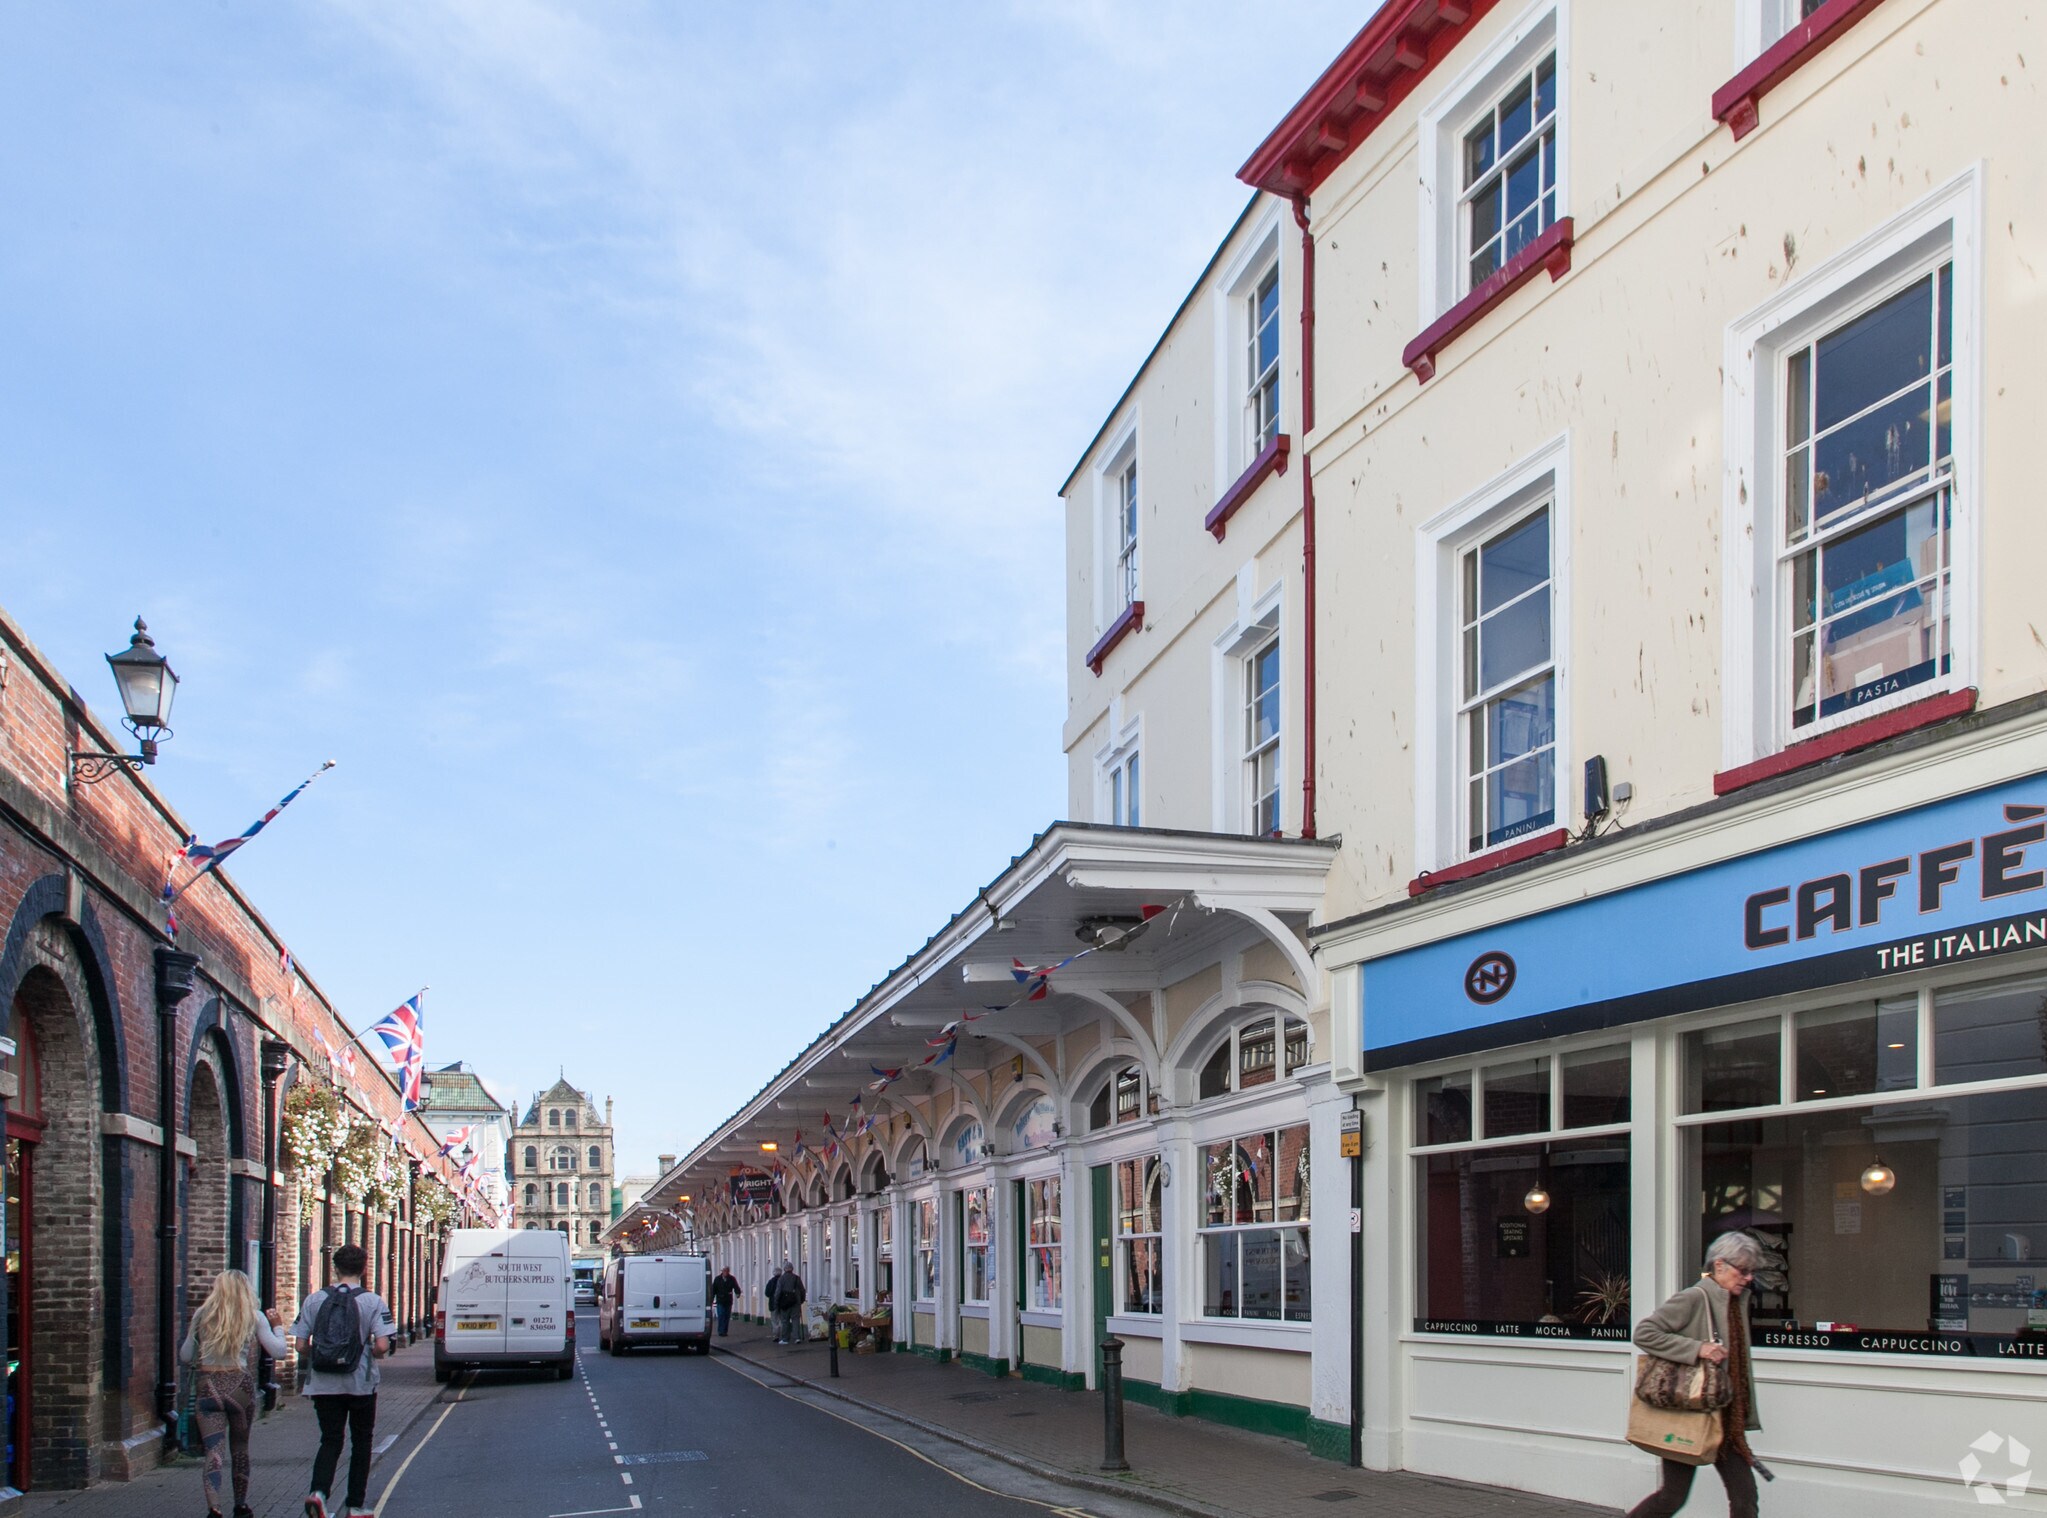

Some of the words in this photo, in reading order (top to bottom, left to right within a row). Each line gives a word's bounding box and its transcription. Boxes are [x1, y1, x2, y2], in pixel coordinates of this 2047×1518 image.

[1857, 679, 1899, 702] PASTA
[1505, 820, 1536, 838] PANINI
[1744, 803, 2046, 950] CAFFÈ
[1877, 941, 1924, 969] THE
[1933, 917, 2046, 960] ITALIAN
[498, 1263, 522, 1272] SOUTH
[524, 1263, 542, 1272] WEST
[485, 1275, 522, 1284] BUTCHERS
[523, 1275, 555, 1284] SUPPLIES
[1424, 1322, 1478, 1332] CAPPUCCINO
[1495, 1325, 1519, 1334] LATTE
[1535, 1327, 1571, 1336] MOCHA
[1591, 1328, 1627, 1338] PANINI
[1765, 1333, 1830, 1346] ESPRESSO
[1860, 1337, 1962, 1352] CAPPUCCINO
[1998, 1342, 2045, 1356] LATTE
